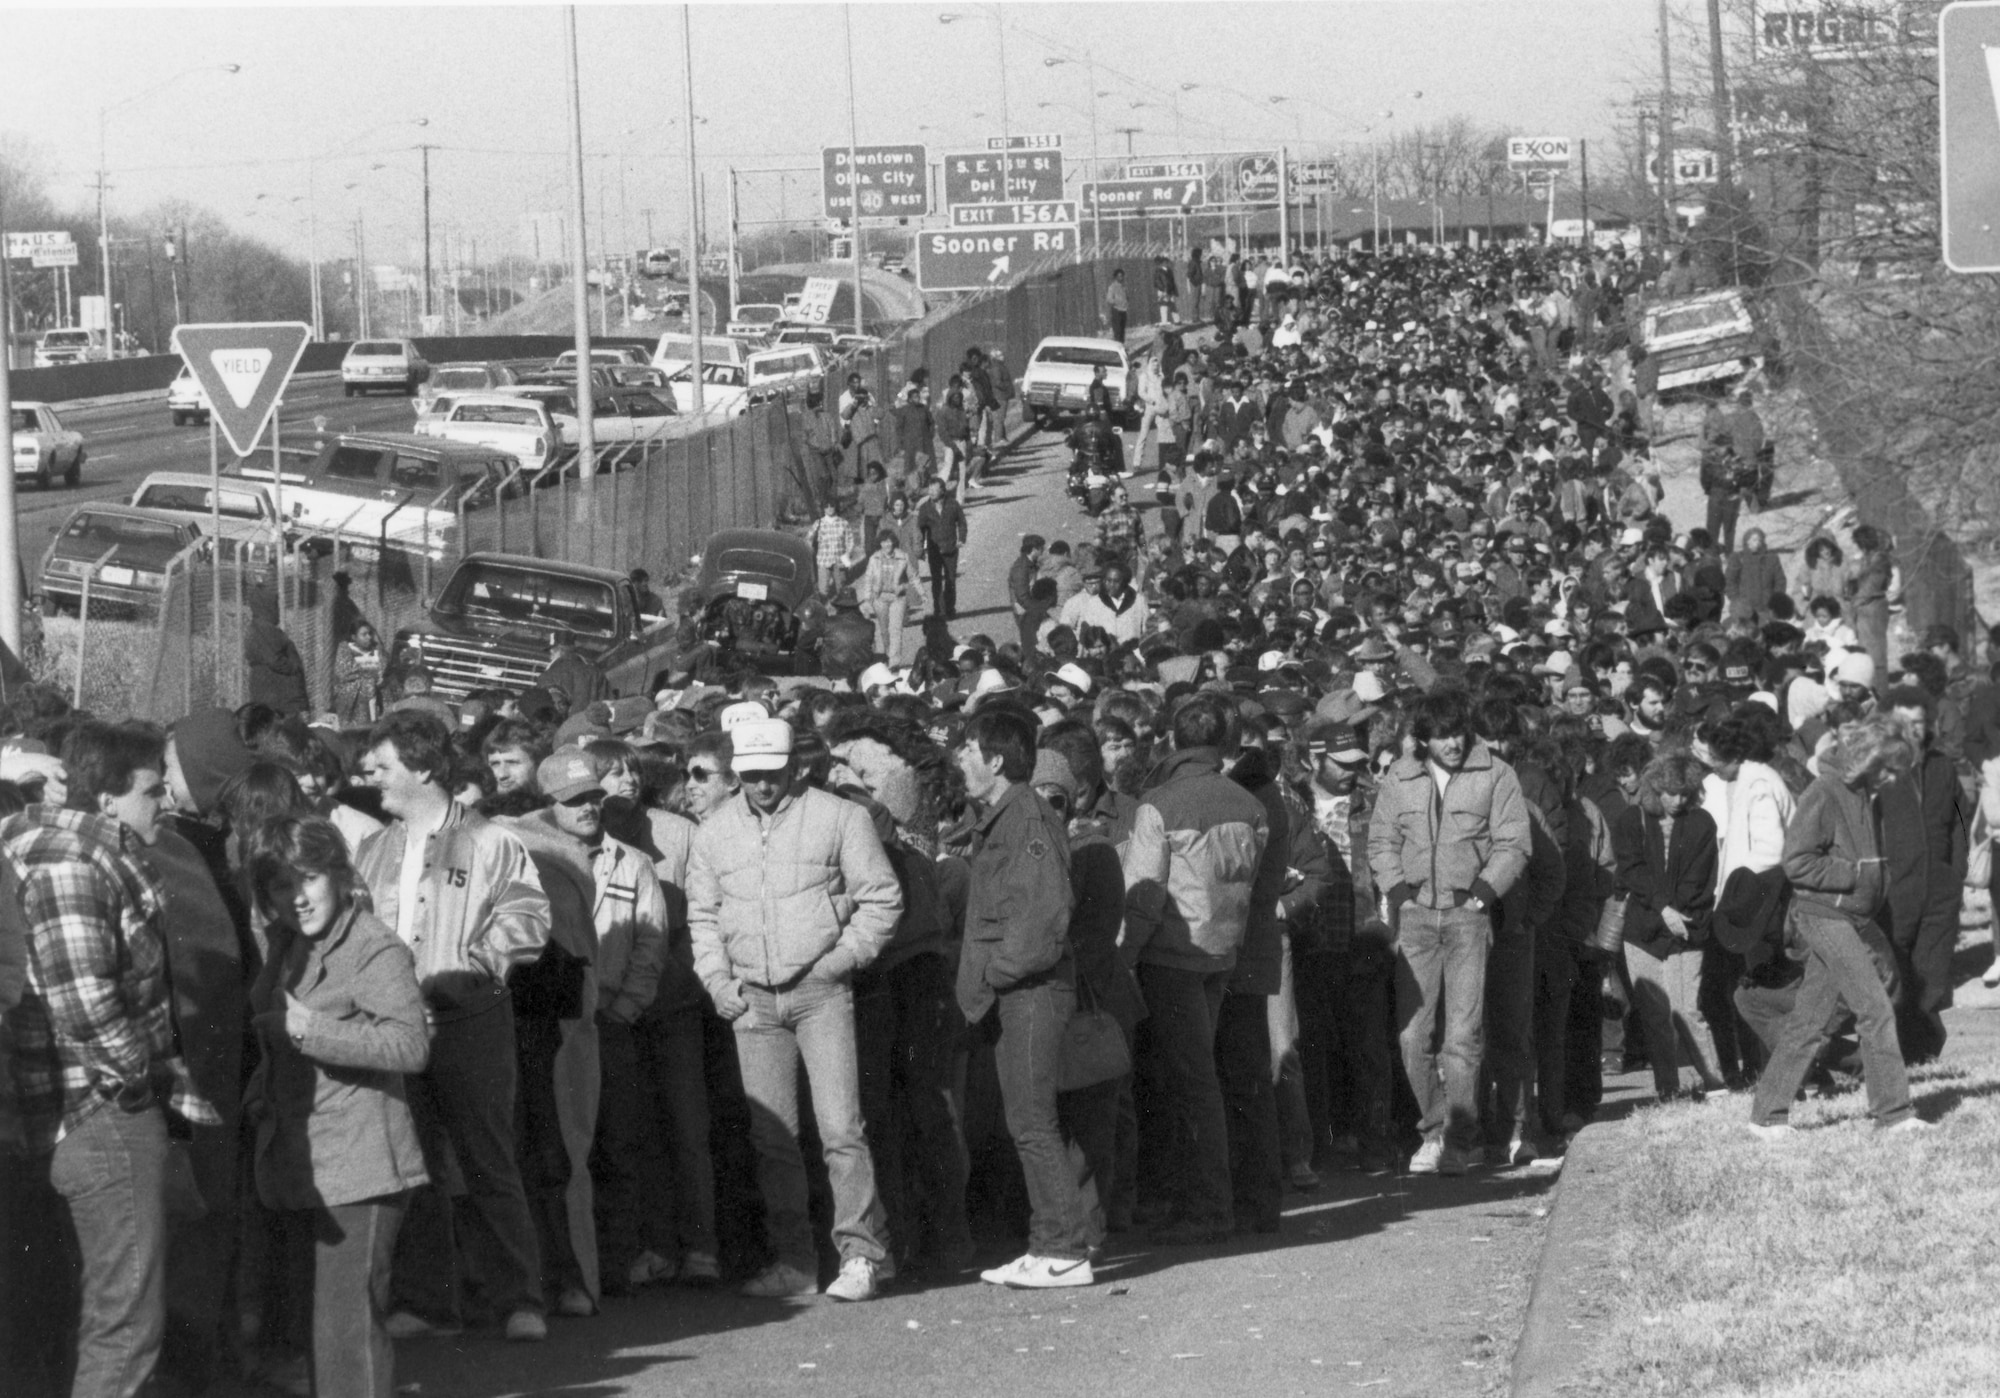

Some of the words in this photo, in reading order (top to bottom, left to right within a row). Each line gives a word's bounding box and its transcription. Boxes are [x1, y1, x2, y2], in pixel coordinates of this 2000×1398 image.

[1512, 141, 1568, 160] EXXON
[1034, 157, 1050, 171] St
[1132, 167, 1154, 177] EXIT
[1165, 164, 1200, 177] 156A
[882, 171, 915, 188] City
[970, 179, 995, 193] Del
[890, 194, 922, 206] WEST
[1153, 187, 1173, 201] Rd
[959, 208, 994, 223] EXIT
[1011, 204, 1069, 223] 156A
[932, 234, 1018, 255] Sooner
[1033, 230, 1065, 252] Rd
[799, 302, 829, 322] 45
[222, 359, 262, 374] YIELD
[447, 867, 468, 889] 15
